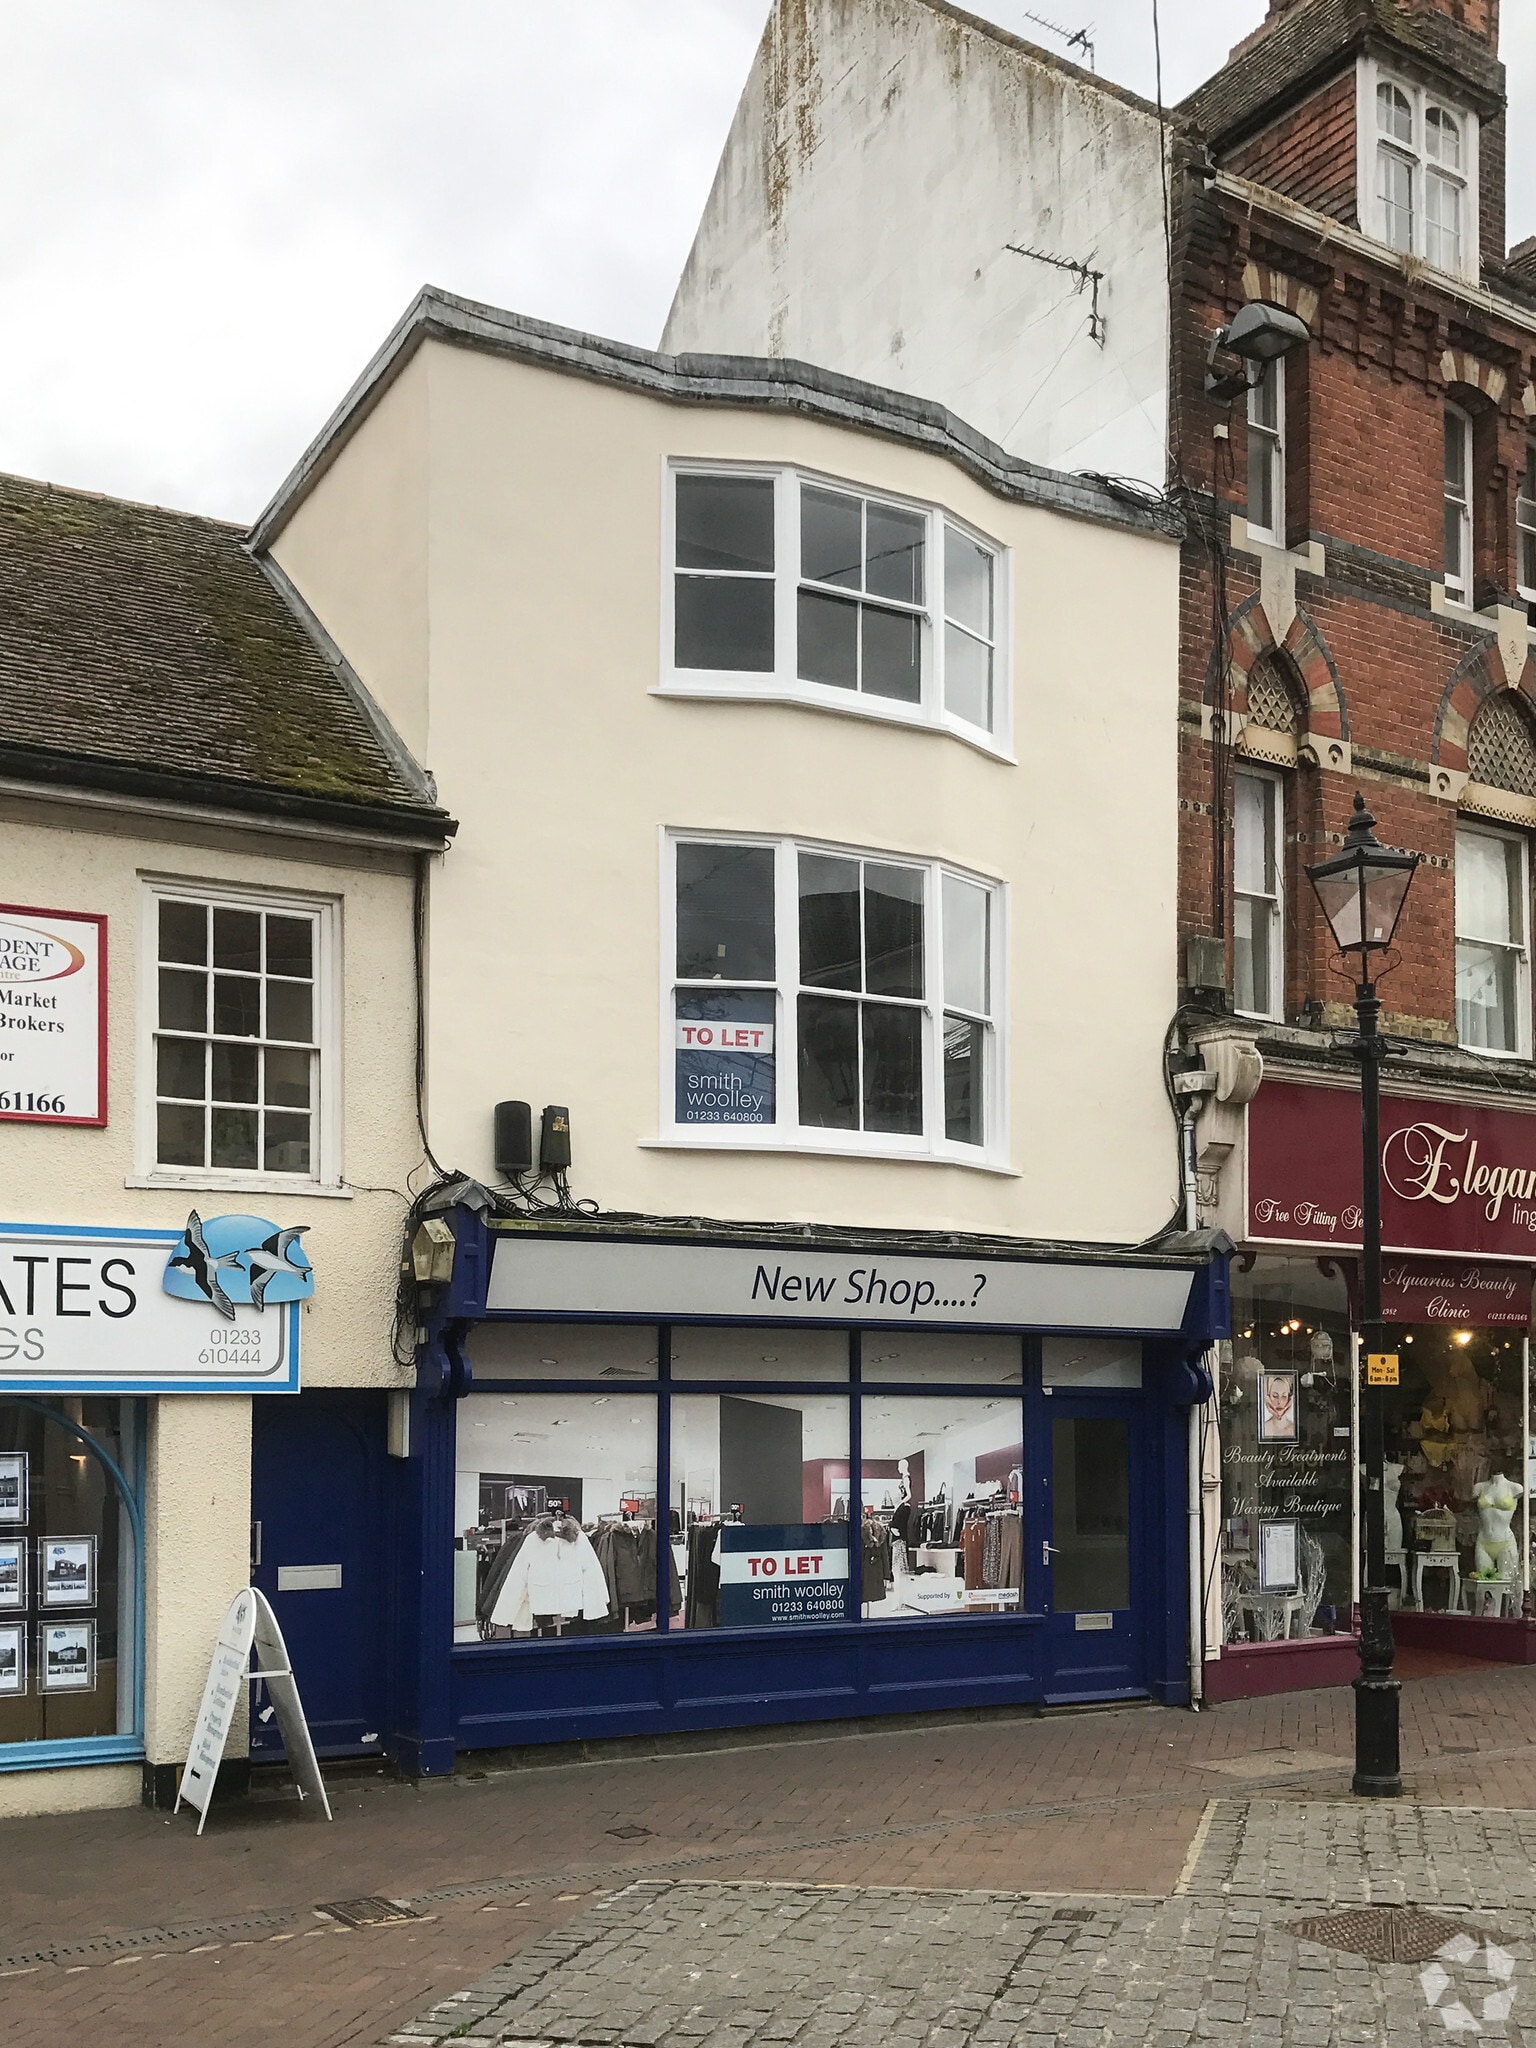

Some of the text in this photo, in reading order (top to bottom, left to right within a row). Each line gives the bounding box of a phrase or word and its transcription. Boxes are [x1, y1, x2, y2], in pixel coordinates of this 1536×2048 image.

[682, 1027, 764, 1048] TO LET
[688, 1072, 742, 1090] smith
[687, 1090, 764, 1112] woolley
[686, 1110, 763, 1122] 01233 640800
[1254, 1198, 1289, 1223] Free
[1293, 1201, 1337, 1232] Fitting
[751, 1265, 987, 1314] New Shop....?
[1382, 1263, 1517, 1300] Aquarius Beauty
[1424, 1295, 1470, 1319] Clinic
[210, 1329, 261, 1345] 01233
[198, 1349, 261, 1364] 610444
[1223, 1444, 1347, 1469] Beauty Treatments
[1254, 1470, 1319, 1488] Available
[1231, 1495, 1342, 1520] Waxing Boutique
[747, 1556, 823, 1576] TO LET
[752, 1582, 844, 1600] smith woolley
[772, 1600, 845, 1613] 01233 640800
[771, 1612, 845, 1622] www.smithwoolley.com
